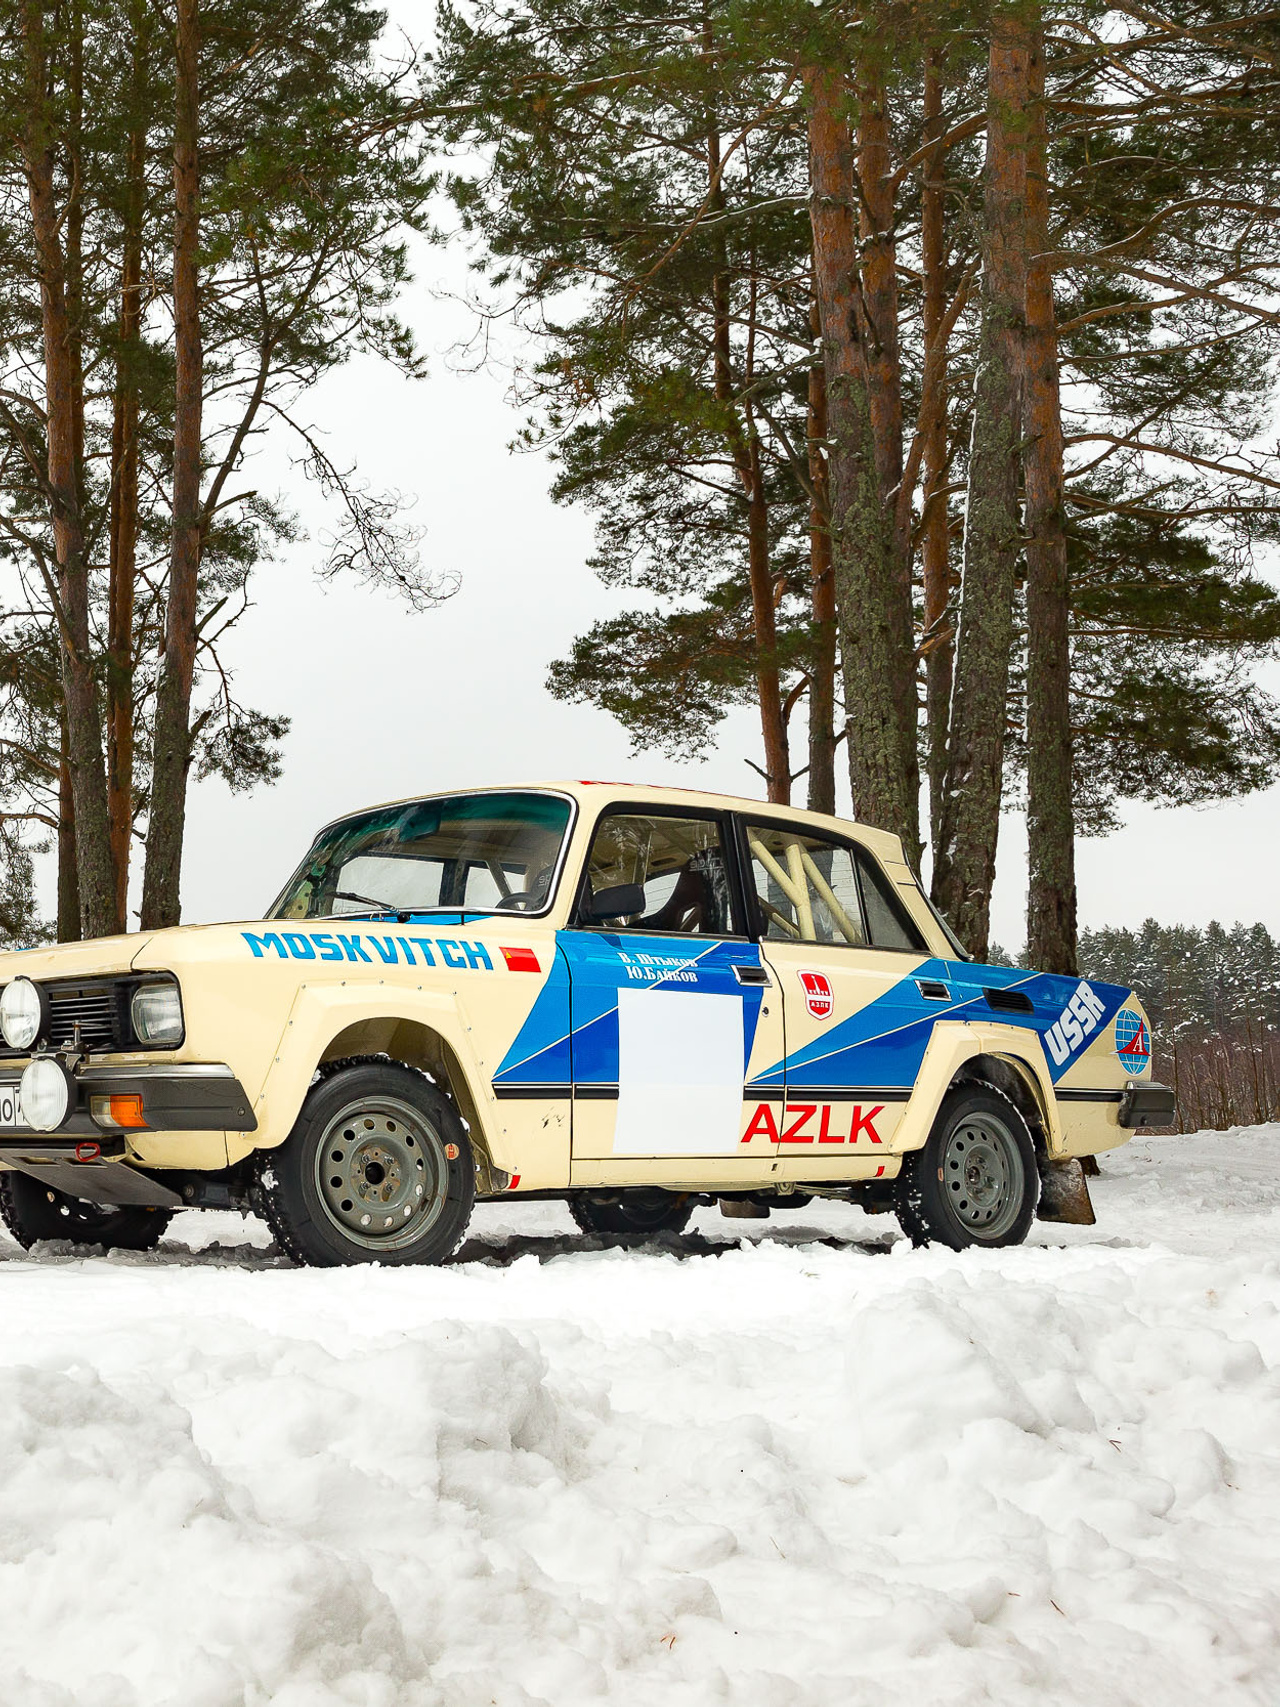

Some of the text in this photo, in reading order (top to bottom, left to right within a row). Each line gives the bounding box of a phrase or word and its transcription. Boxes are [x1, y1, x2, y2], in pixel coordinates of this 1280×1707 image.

[240, 932, 494, 971] MOSKVITCH
[1043, 980, 1107, 1067] USSR
[740, 1103, 886, 1144] AZLK
